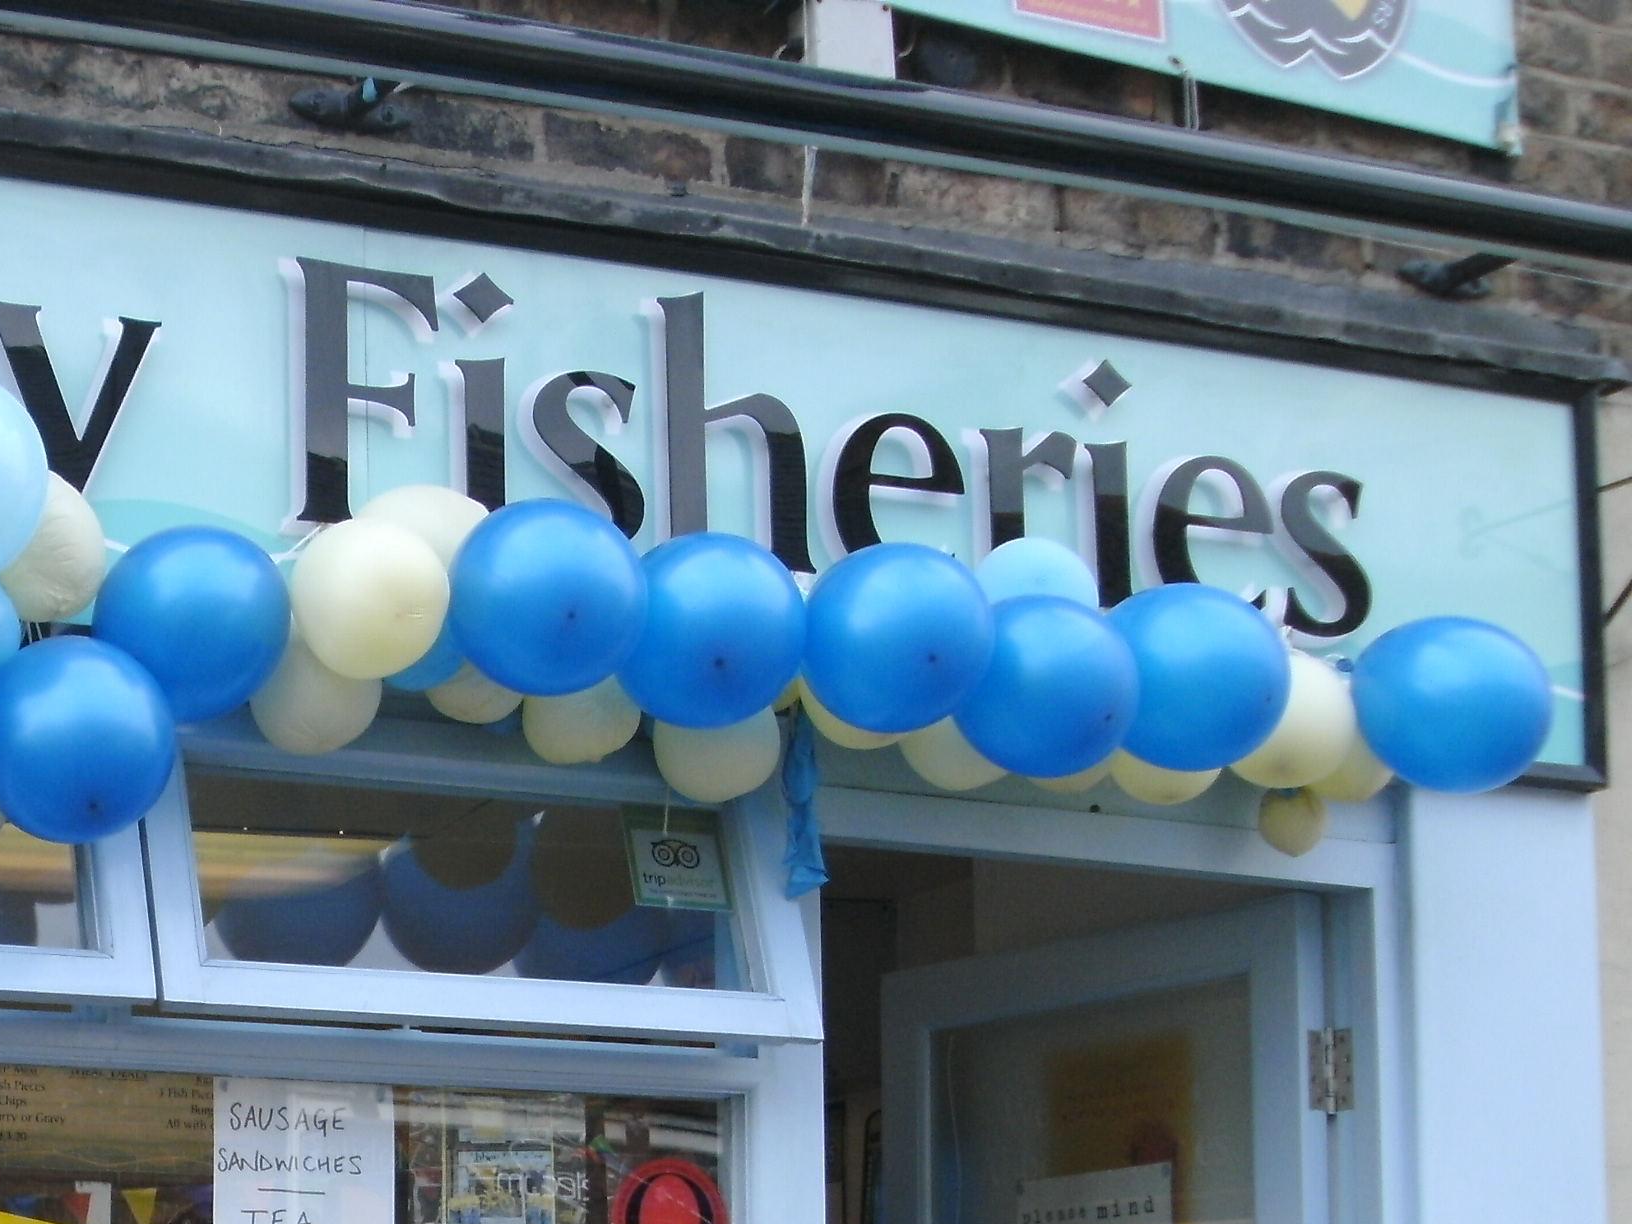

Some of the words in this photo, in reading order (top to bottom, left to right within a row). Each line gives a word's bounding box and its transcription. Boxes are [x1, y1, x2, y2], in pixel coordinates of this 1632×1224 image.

[288, 254, 1372, 640] Fisheries
[229, 1101, 348, 1138] SAUSAGE
[218, 1147, 363, 1176] SANDWICHES
[1096, 1194, 1156, 1221] mind
